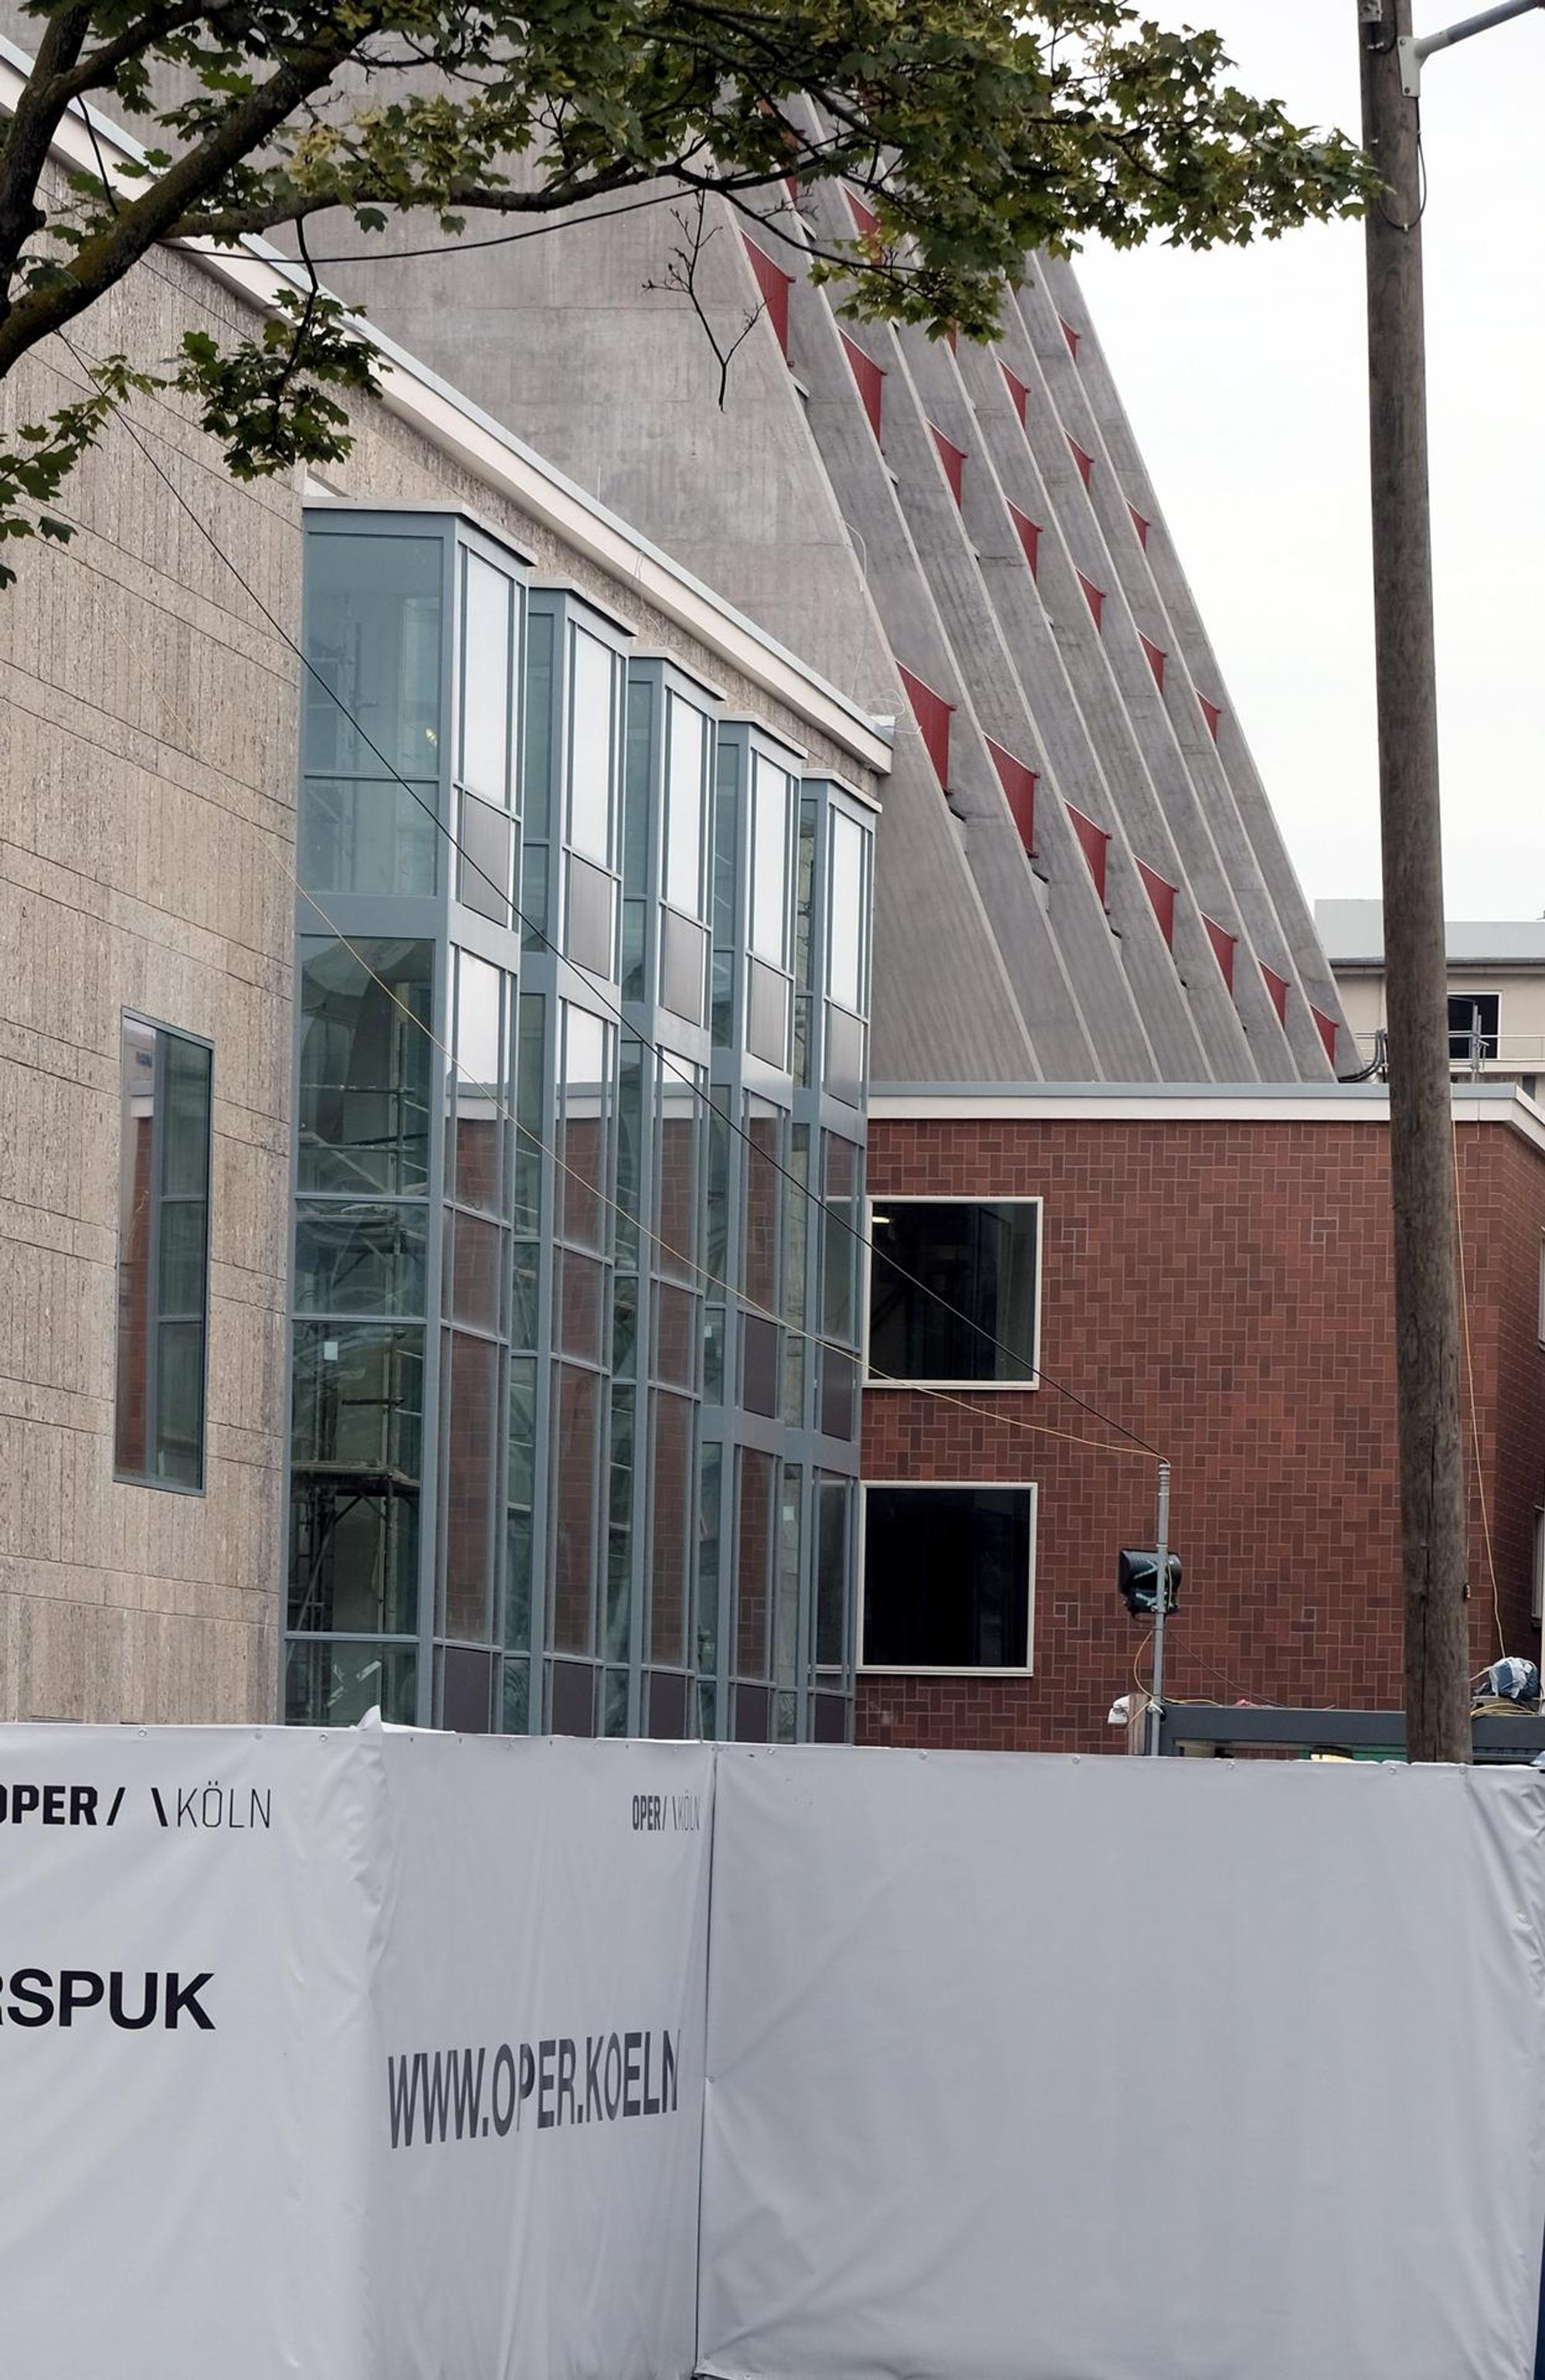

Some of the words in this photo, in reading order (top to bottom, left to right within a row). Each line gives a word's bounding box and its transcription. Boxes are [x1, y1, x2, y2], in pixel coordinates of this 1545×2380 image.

[0, 1784, 125, 1825] PER/
[0, 1968, 216, 2030] SPUK
[389, 2029, 680, 2148] WWW.OPER.KOELN
